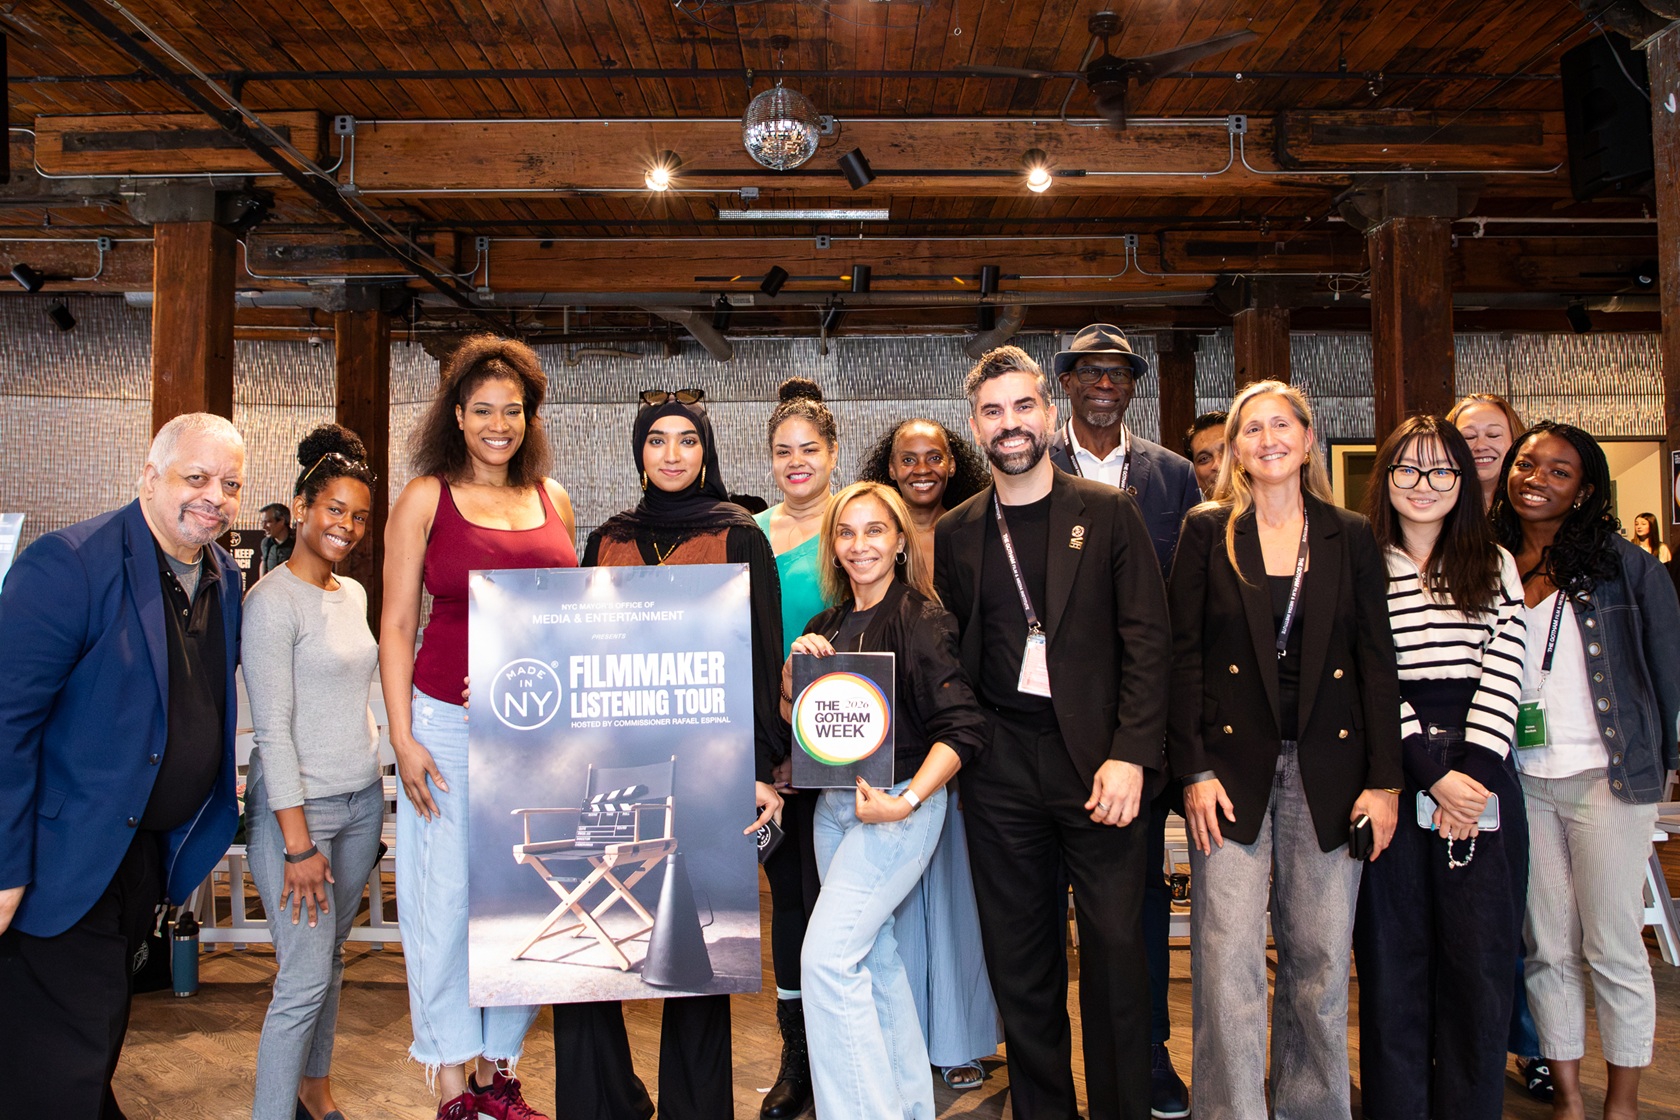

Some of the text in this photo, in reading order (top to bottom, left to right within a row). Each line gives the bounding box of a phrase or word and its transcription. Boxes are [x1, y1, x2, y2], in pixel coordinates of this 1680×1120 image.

[1002, 533, 1010, 543] THE
[234, 548, 254, 559] KEEP
[1005, 543, 1016, 564] GOTHAM
[1294, 566, 1303, 587] GOTHAM
[561, 601, 655, 611] NYC MAYOR'S OFFICE OF
[532, 610, 685, 625] MEDIA & ENTERTAINMENT
[591, 633, 627, 641] PRESENTS
[1549, 619, 1560, 642] GOTHAM
[1547, 641, 1555, 653] THE
[505, 665, 547, 681] MADE
[569, 651, 726, 689] FILMMAKER
[519, 679, 533, 688] IN
[504, 690, 554, 718] NY
[570, 687, 726, 719] LISTENING TOUR
[815, 700, 840, 711] THE
[571, 716, 731, 729] HOSTED BY COMMISSIONER RAFAEL ESPINAL
[814, 712, 870, 723] GOTHAM
[815, 724, 865, 738] WEEK
